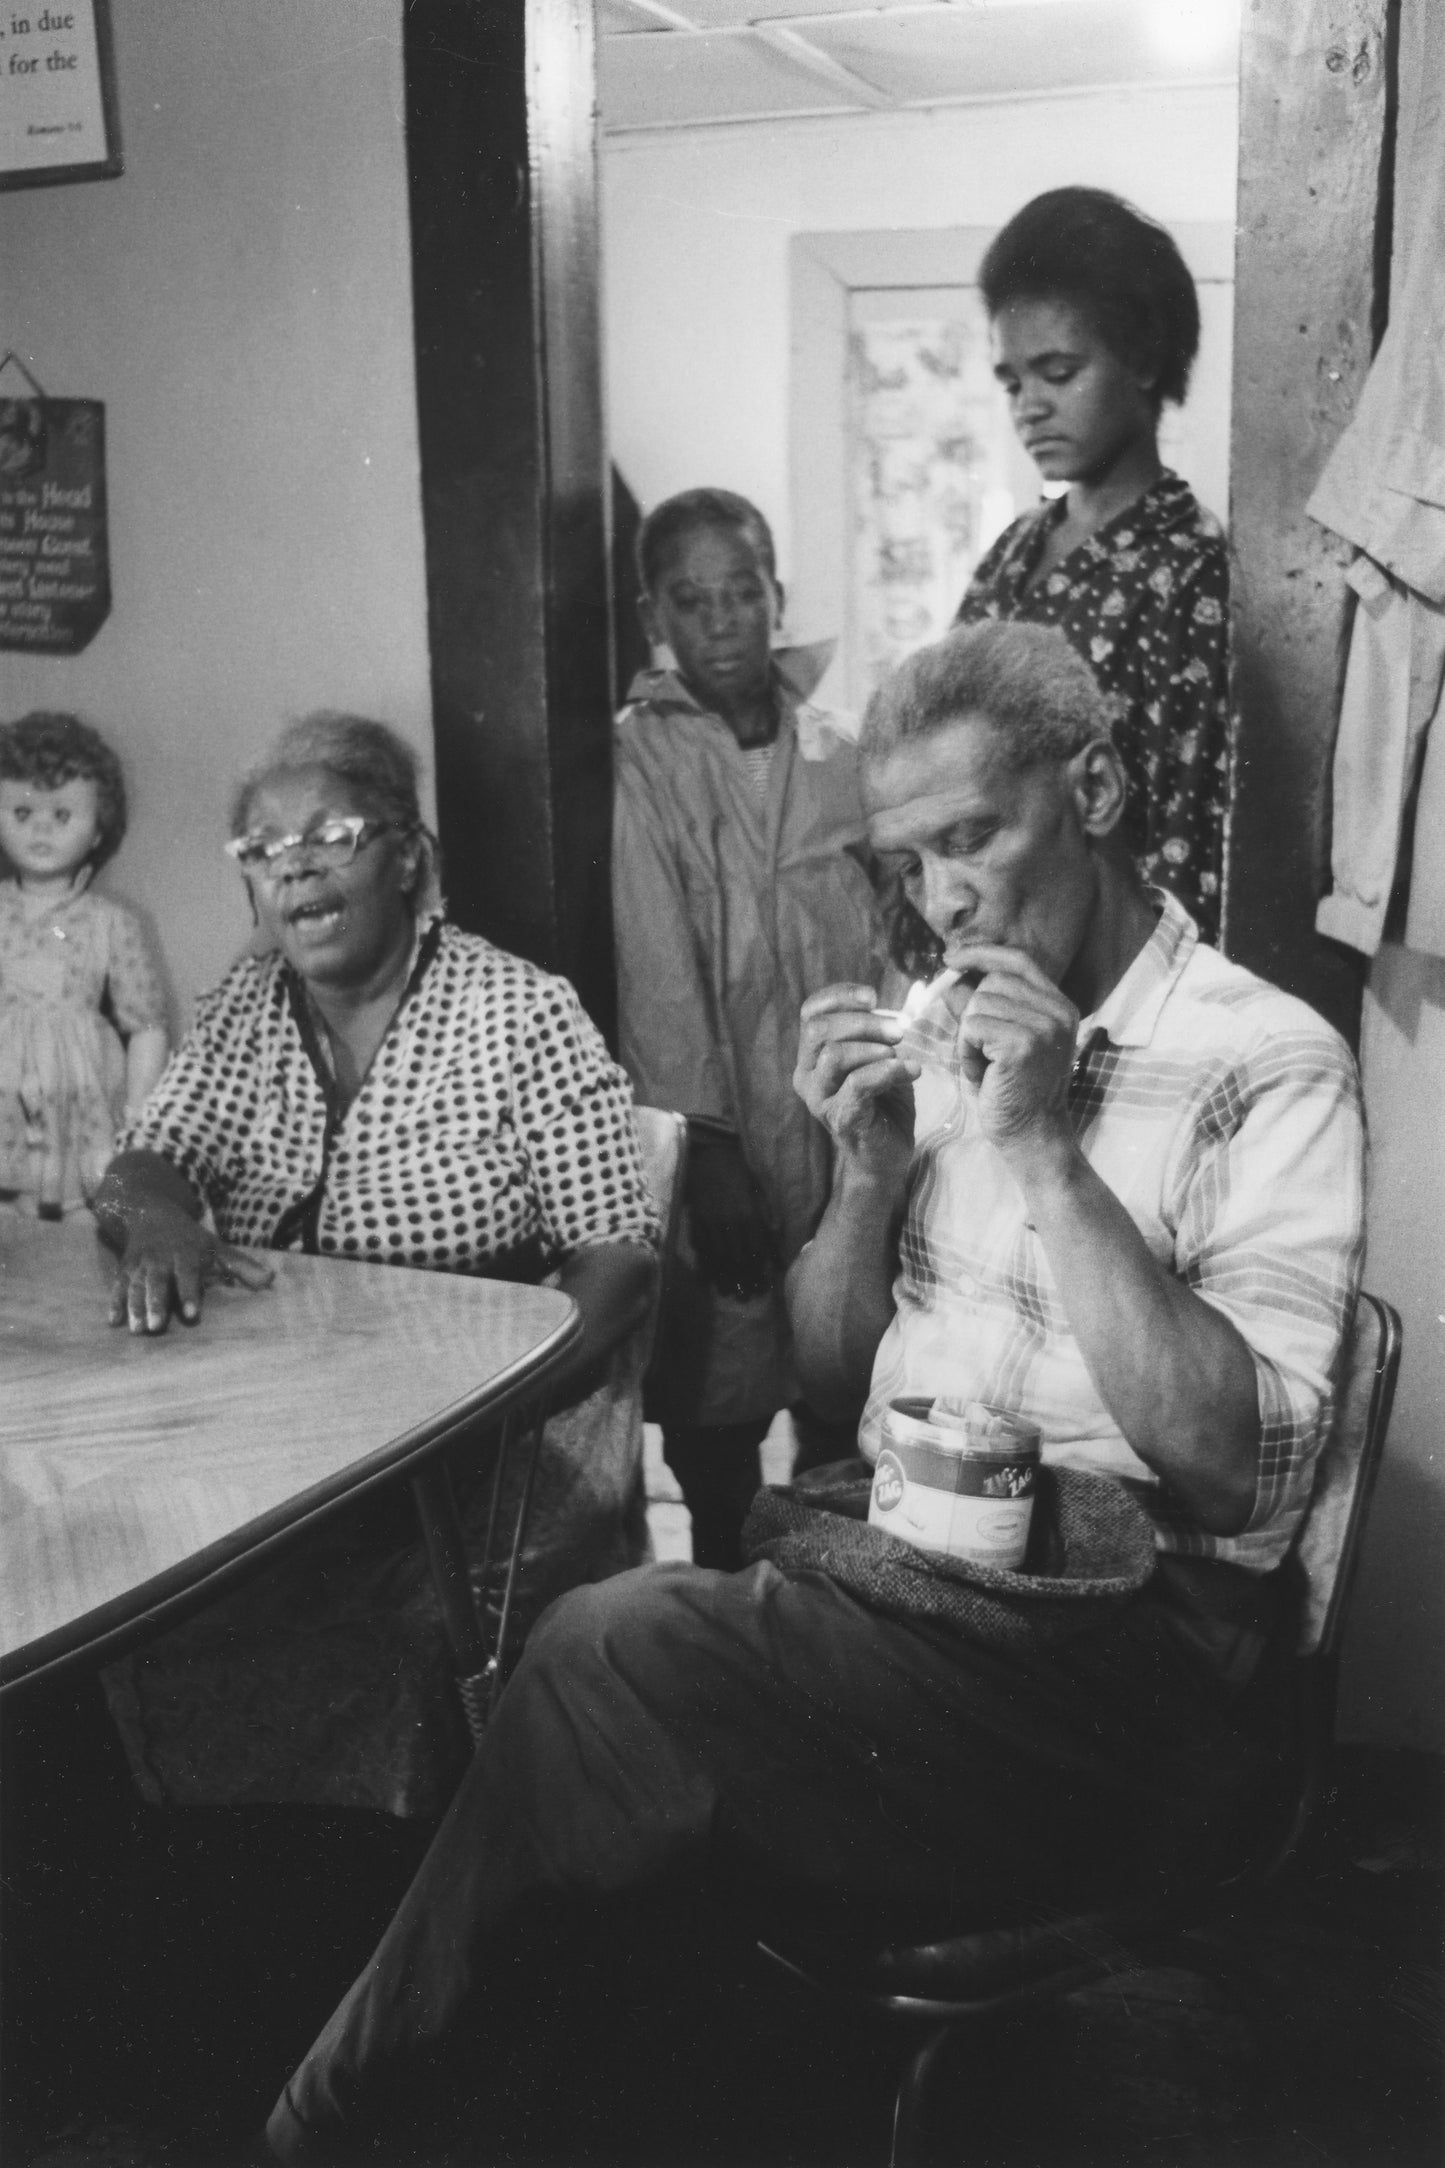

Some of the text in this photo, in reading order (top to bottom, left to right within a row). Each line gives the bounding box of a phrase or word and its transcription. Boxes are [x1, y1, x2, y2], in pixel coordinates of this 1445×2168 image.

[11, 9, 74, 35] in due
[9, 53, 39, 75] for
[46, 50, 78, 71] the
[41, 481, 93, 510] Head
[879, 1480, 901, 1502] ZAG
[1009, 1467, 1033, 1497] ZAG
